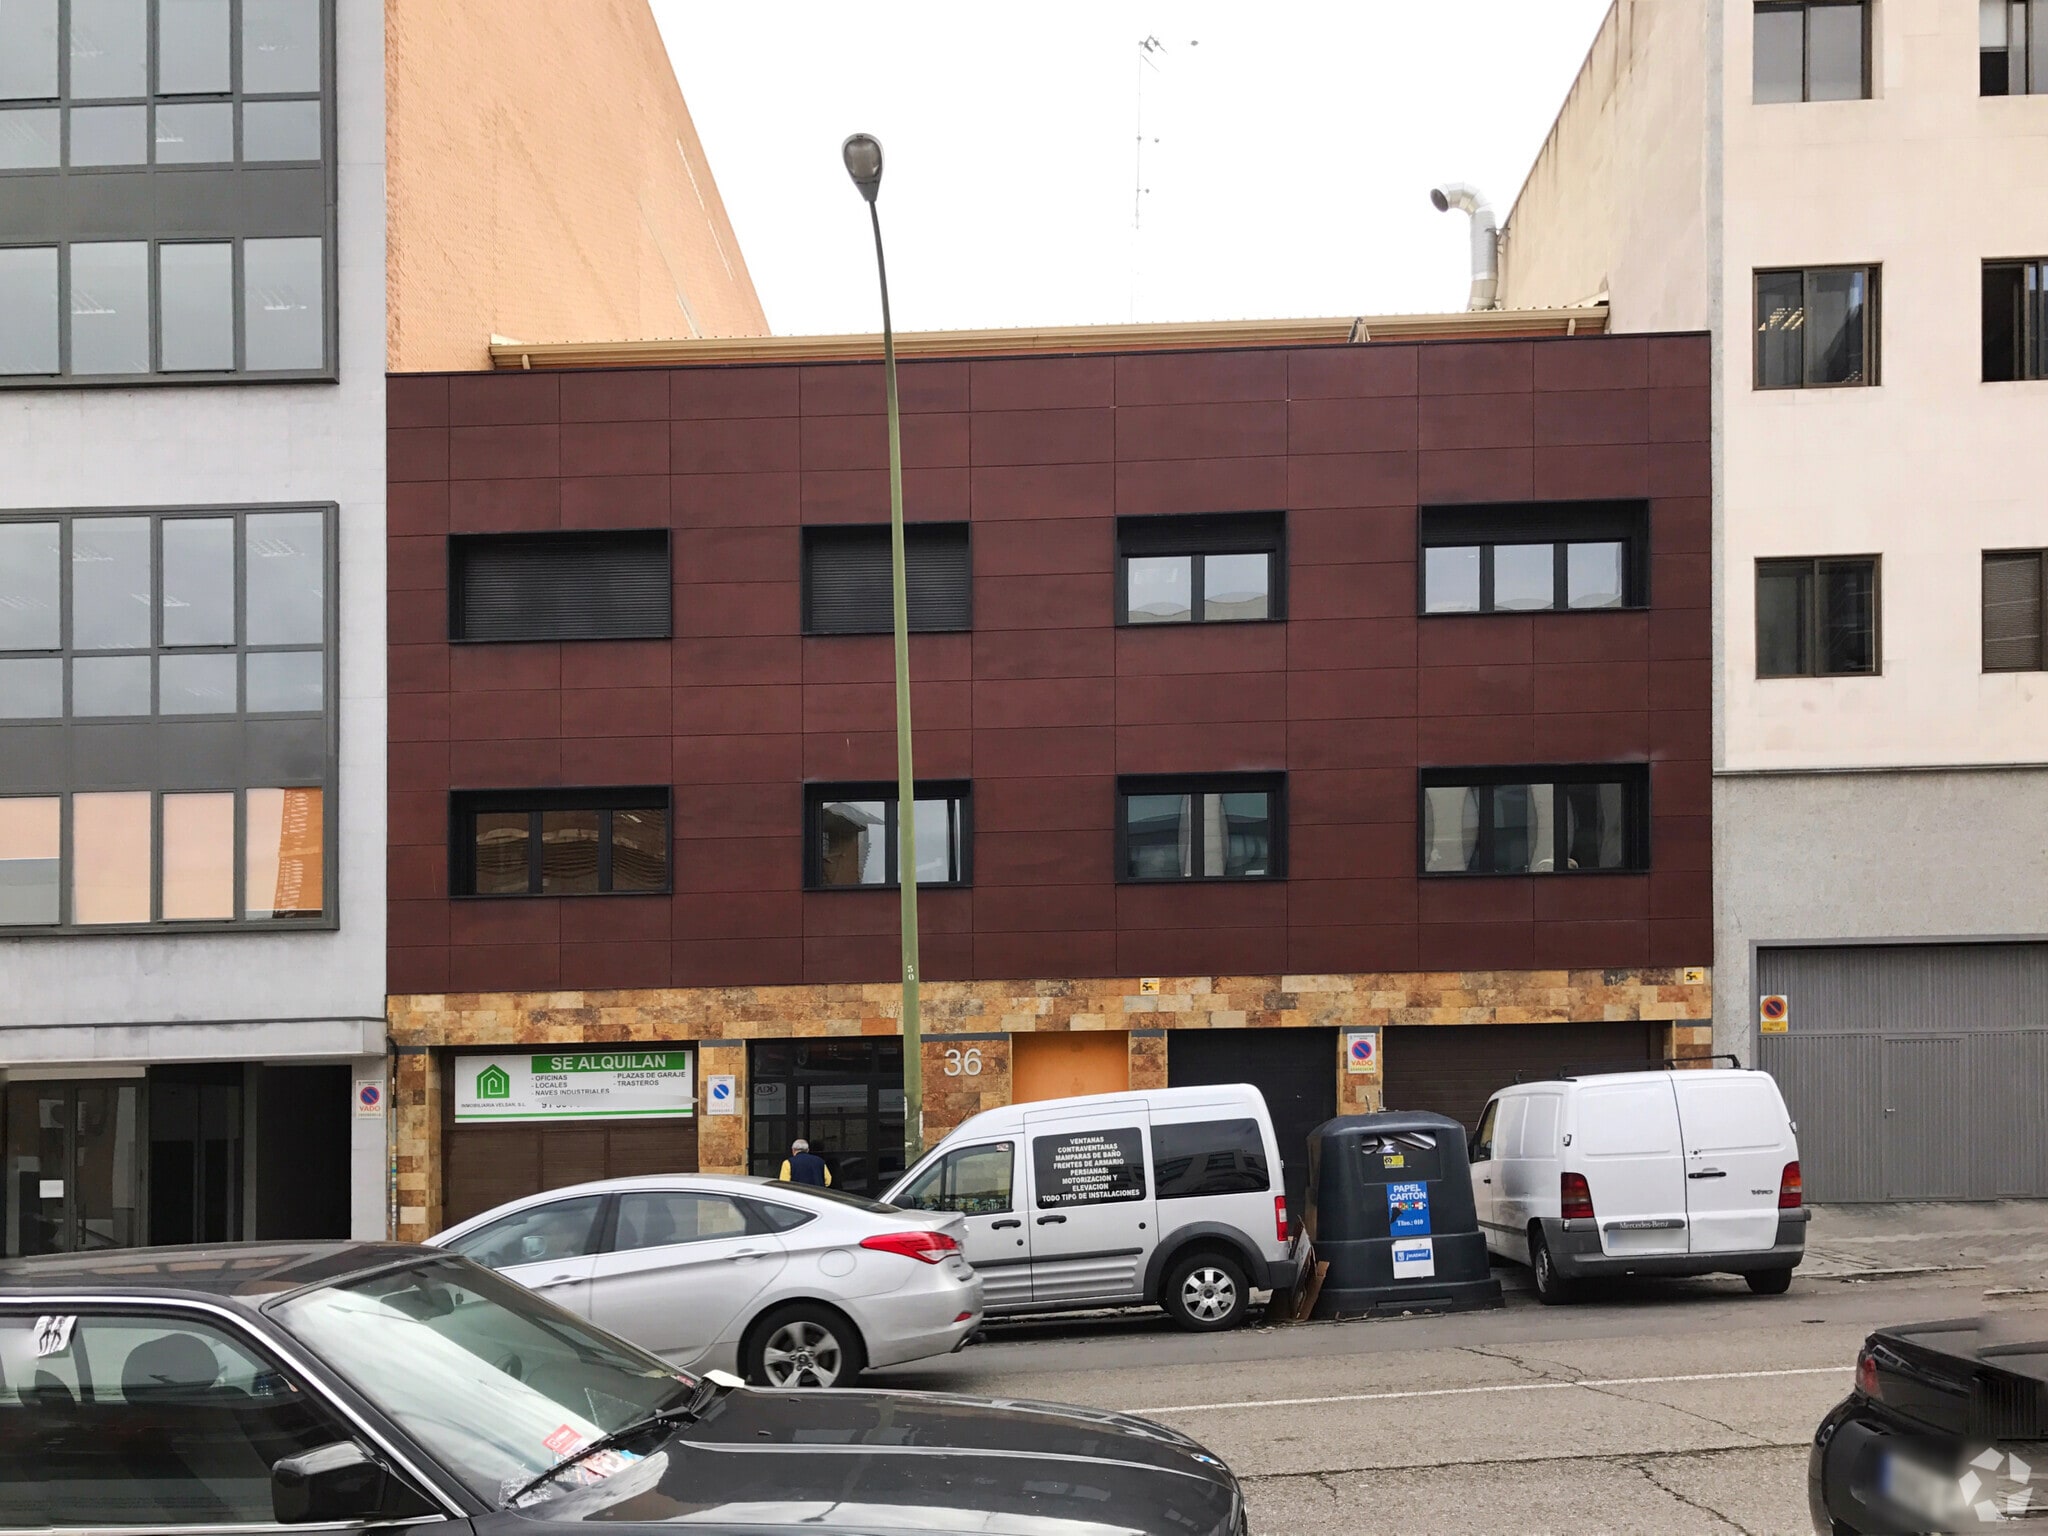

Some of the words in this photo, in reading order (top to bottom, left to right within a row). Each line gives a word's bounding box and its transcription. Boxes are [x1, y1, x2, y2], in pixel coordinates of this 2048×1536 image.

[551, 1056, 574, 1070] SE
[577, 1054, 666, 1070] ALQUILAN
[943, 1048, 982, 1076] 36
[1070, 1136, 1104, 1144] VENTANAS
[1057, 1143, 1118, 1153] CONTRAVENTANAS
[1055, 1152, 1092, 1161] MAMPARAS
[1103, 1150, 1121, 1158] BAÑO
[1053, 1161, 1083, 1170] FRENTES
[1094, 1158, 1124, 1166] ARMARIO
[1070, 1167, 1109, 1176] PERSIANAS:
[1062, 1175, 1111, 1184] MOTORIZACION
[1072, 1183, 1109, 1192] ELEVACION
[1393, 1184, 1422, 1193] PAPEL
[1042, 1194, 1061, 1202] TODO
[1088, 1189, 1140, 1199] INSTALACIONES
[1389, 1191, 1427, 1201] CARTÓN
[1619, 1220, 1669, 1229] Mercedes-Benz
